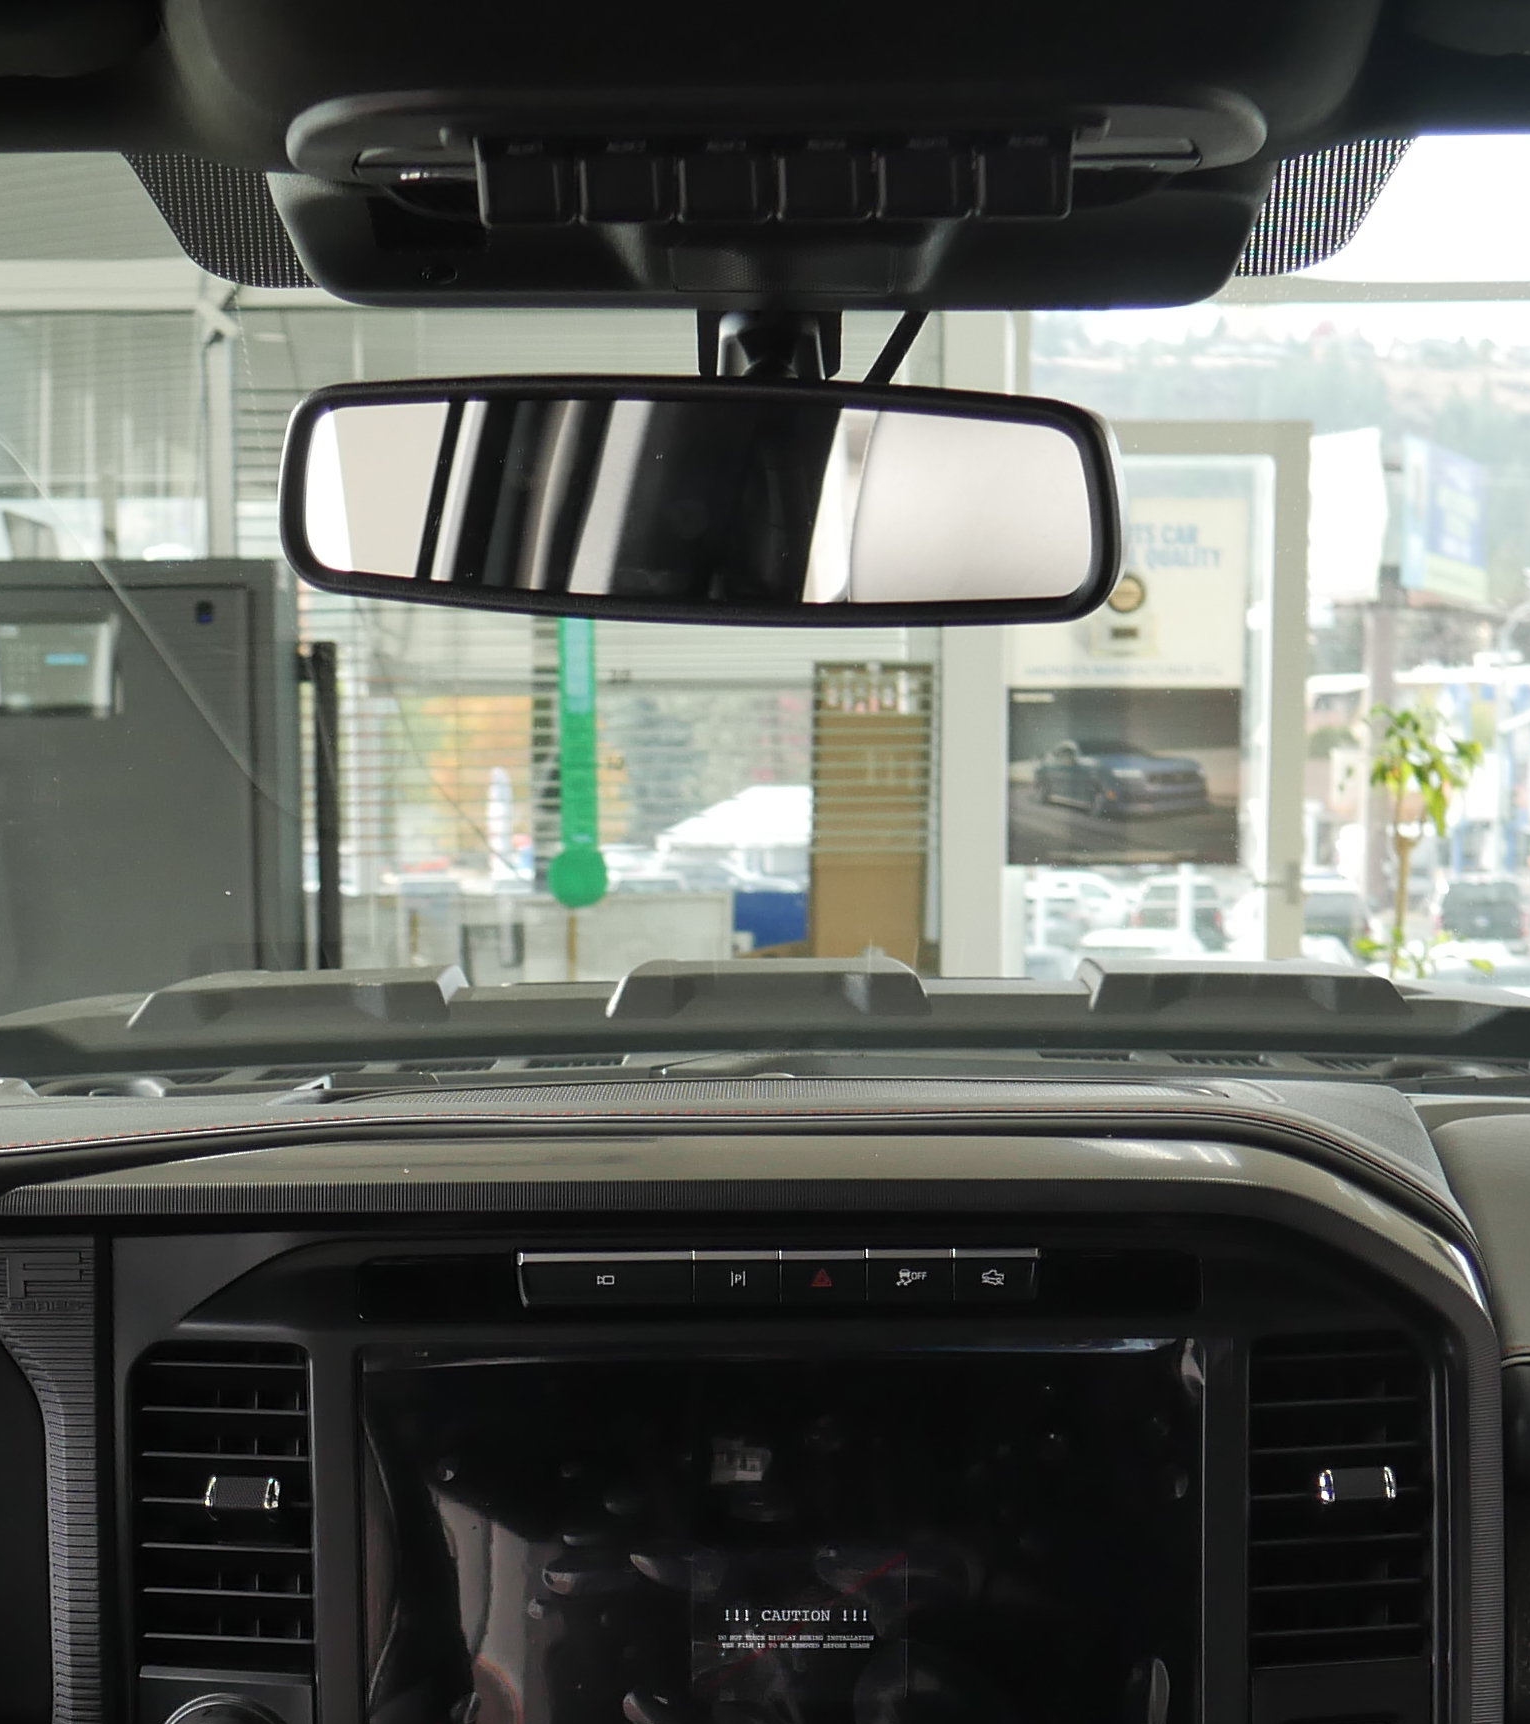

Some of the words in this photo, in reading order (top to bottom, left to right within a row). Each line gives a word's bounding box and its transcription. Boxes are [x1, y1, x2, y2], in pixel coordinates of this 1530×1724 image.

[1145, 547, 1220, 569] QUALITY
[910, 1270, 928, 1282] OFF
[761, 1610, 831, 1622] CAUTION
